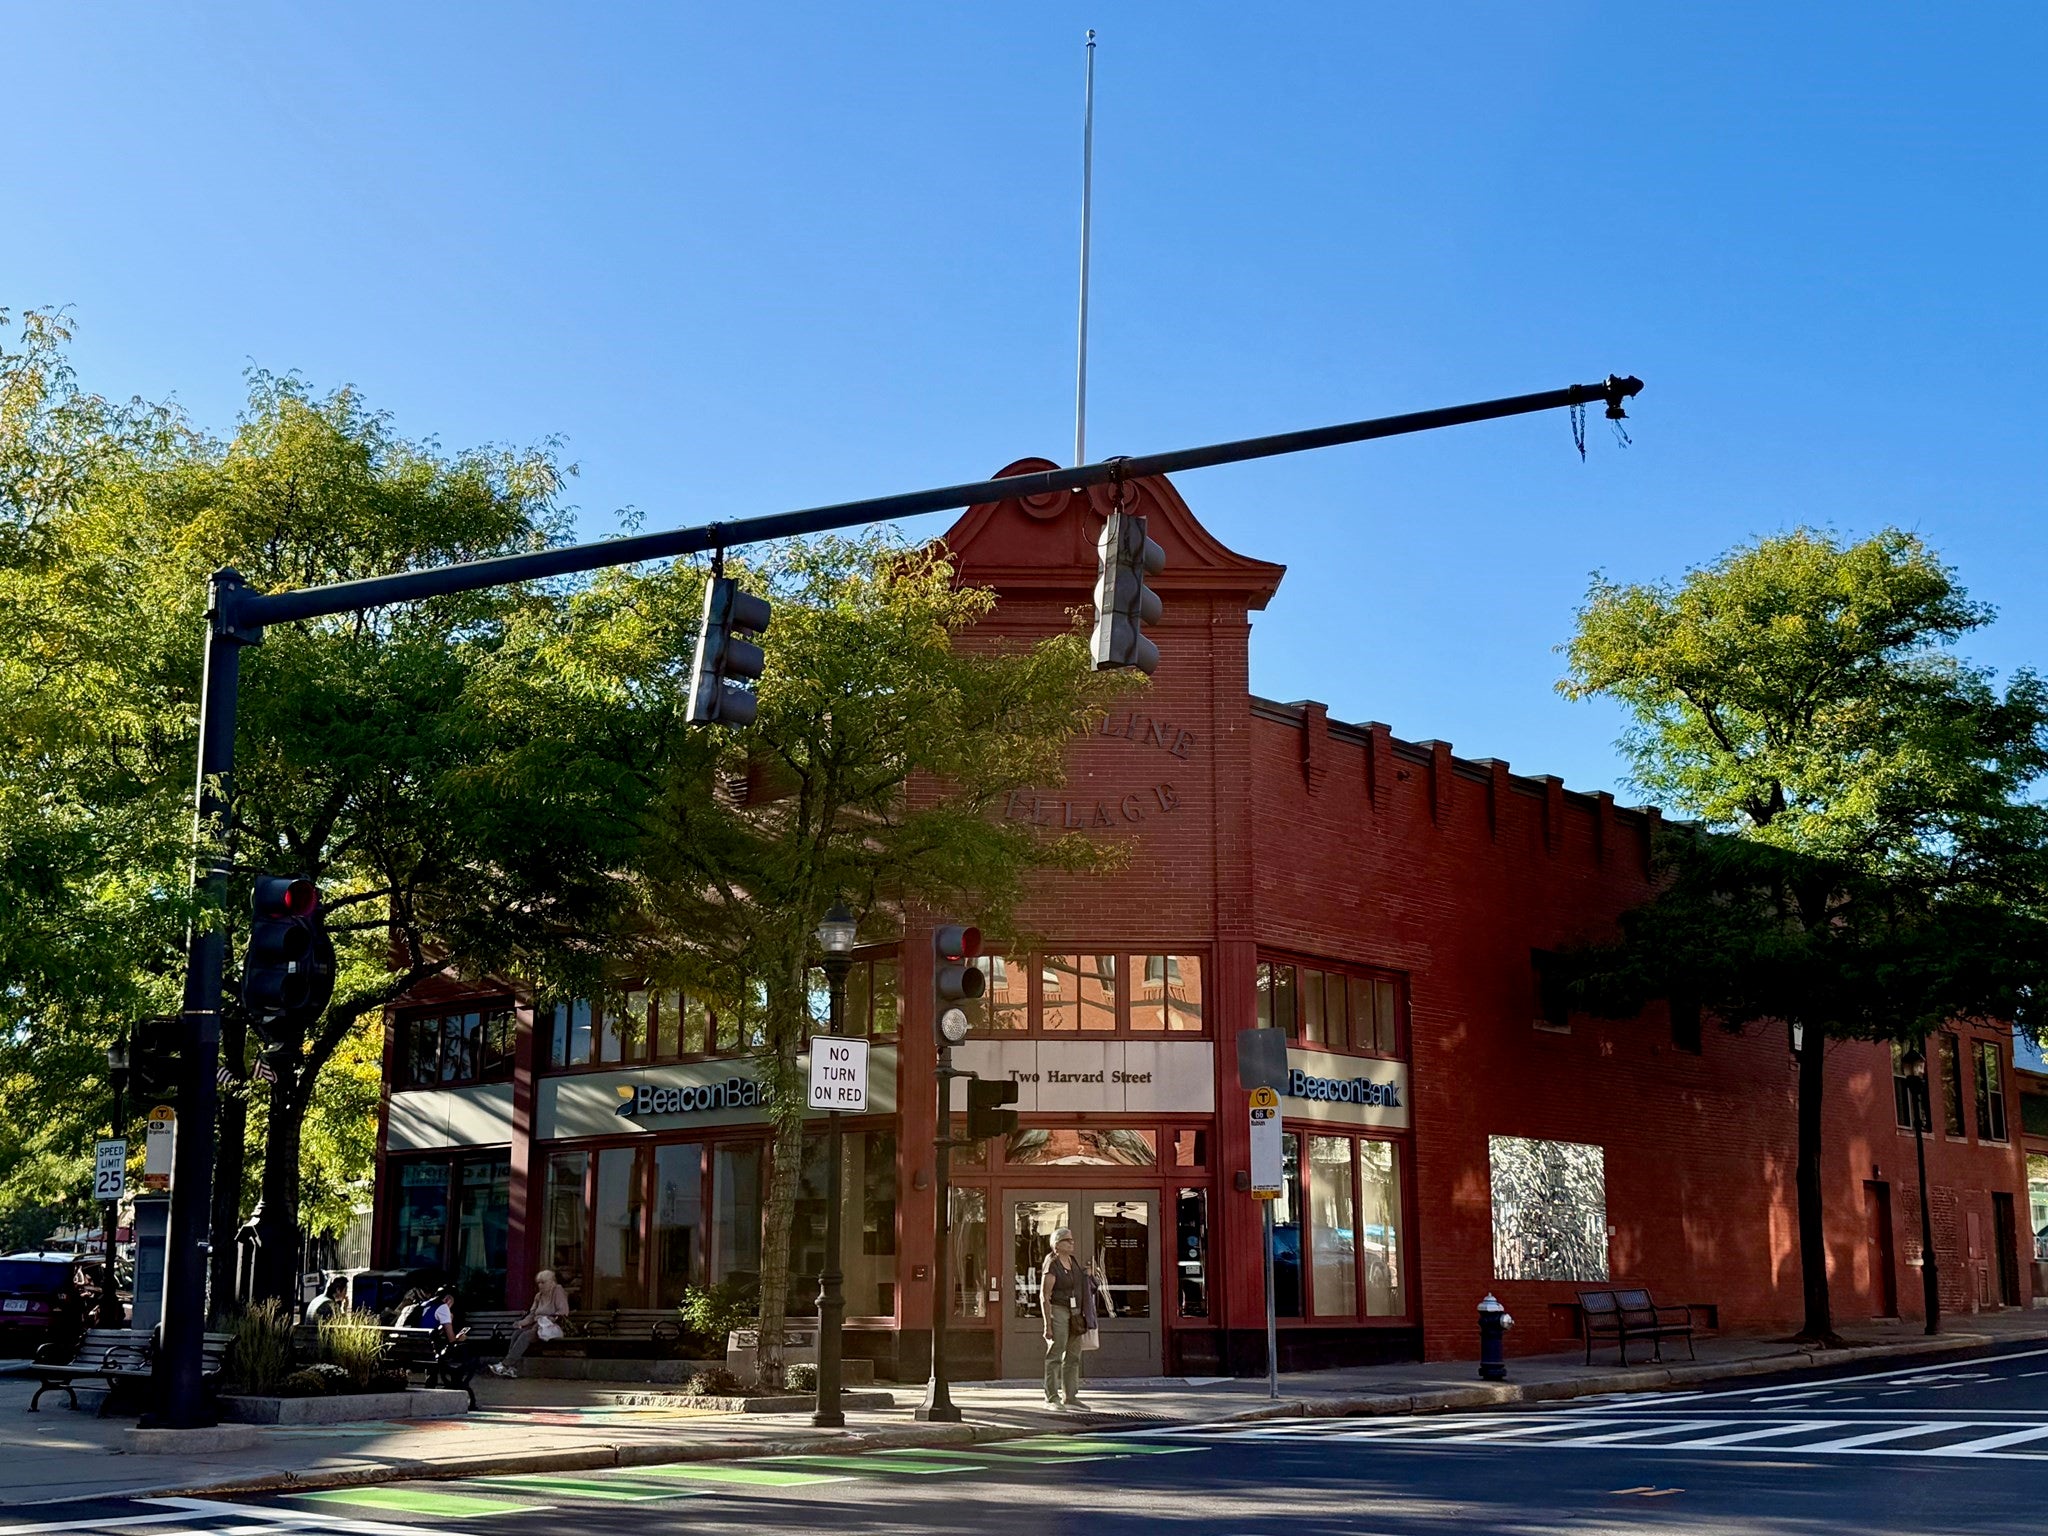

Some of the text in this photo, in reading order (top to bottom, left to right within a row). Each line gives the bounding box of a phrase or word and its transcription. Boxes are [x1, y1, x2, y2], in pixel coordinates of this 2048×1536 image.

[1004, 781, 1181, 829] ILLAGE
[830, 1047, 849, 1062] NO
[823, 1066, 855, 1082] TURN
[1009, 1070, 1152, 1083] Two Harvard Street
[815, 1086, 862, 1101] ON RED
[1293, 1068, 1402, 1107] BeaconBank
[1255, 1110, 1264, 1119] 66
[99, 1146, 124, 1157] SPEED
[1077, 1145, 1085, 1155] 2
[101, 1158, 121, 1169] LIMIT
[97, 1171, 121, 1192] 25
